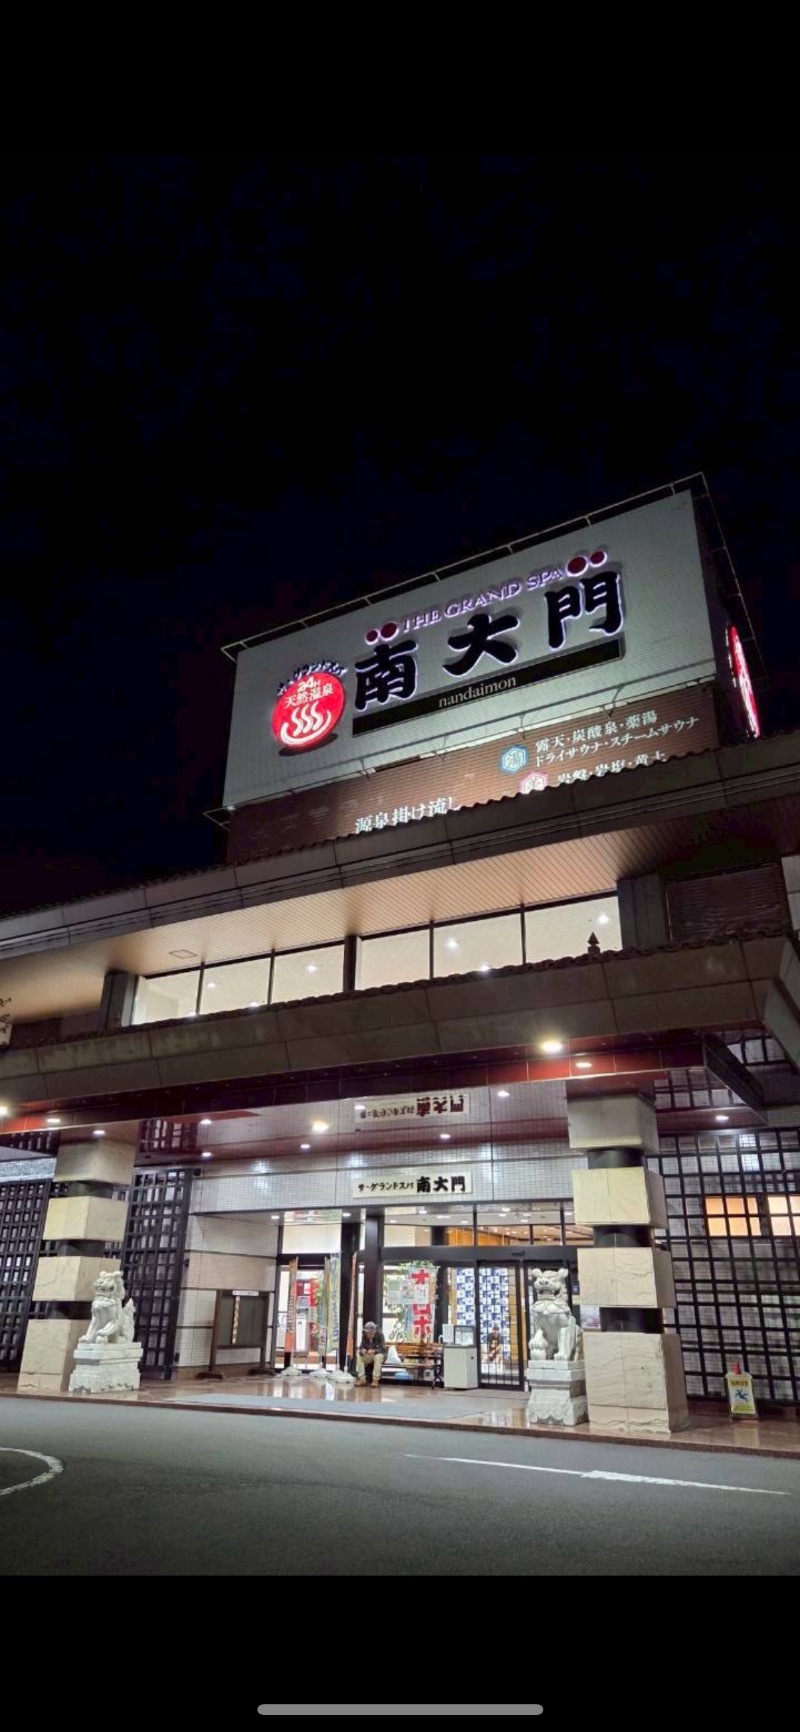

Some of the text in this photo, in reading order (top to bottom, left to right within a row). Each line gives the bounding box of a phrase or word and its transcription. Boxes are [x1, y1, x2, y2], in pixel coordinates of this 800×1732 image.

[403, 566, 566, 634] THE GRAND SPA
[354, 571, 624, 711] 南大門
[285, 682, 334, 709] 天然温泉
[438, 676, 517, 708] nandaimon
[416, 1176, 466, 1193] 南大門
